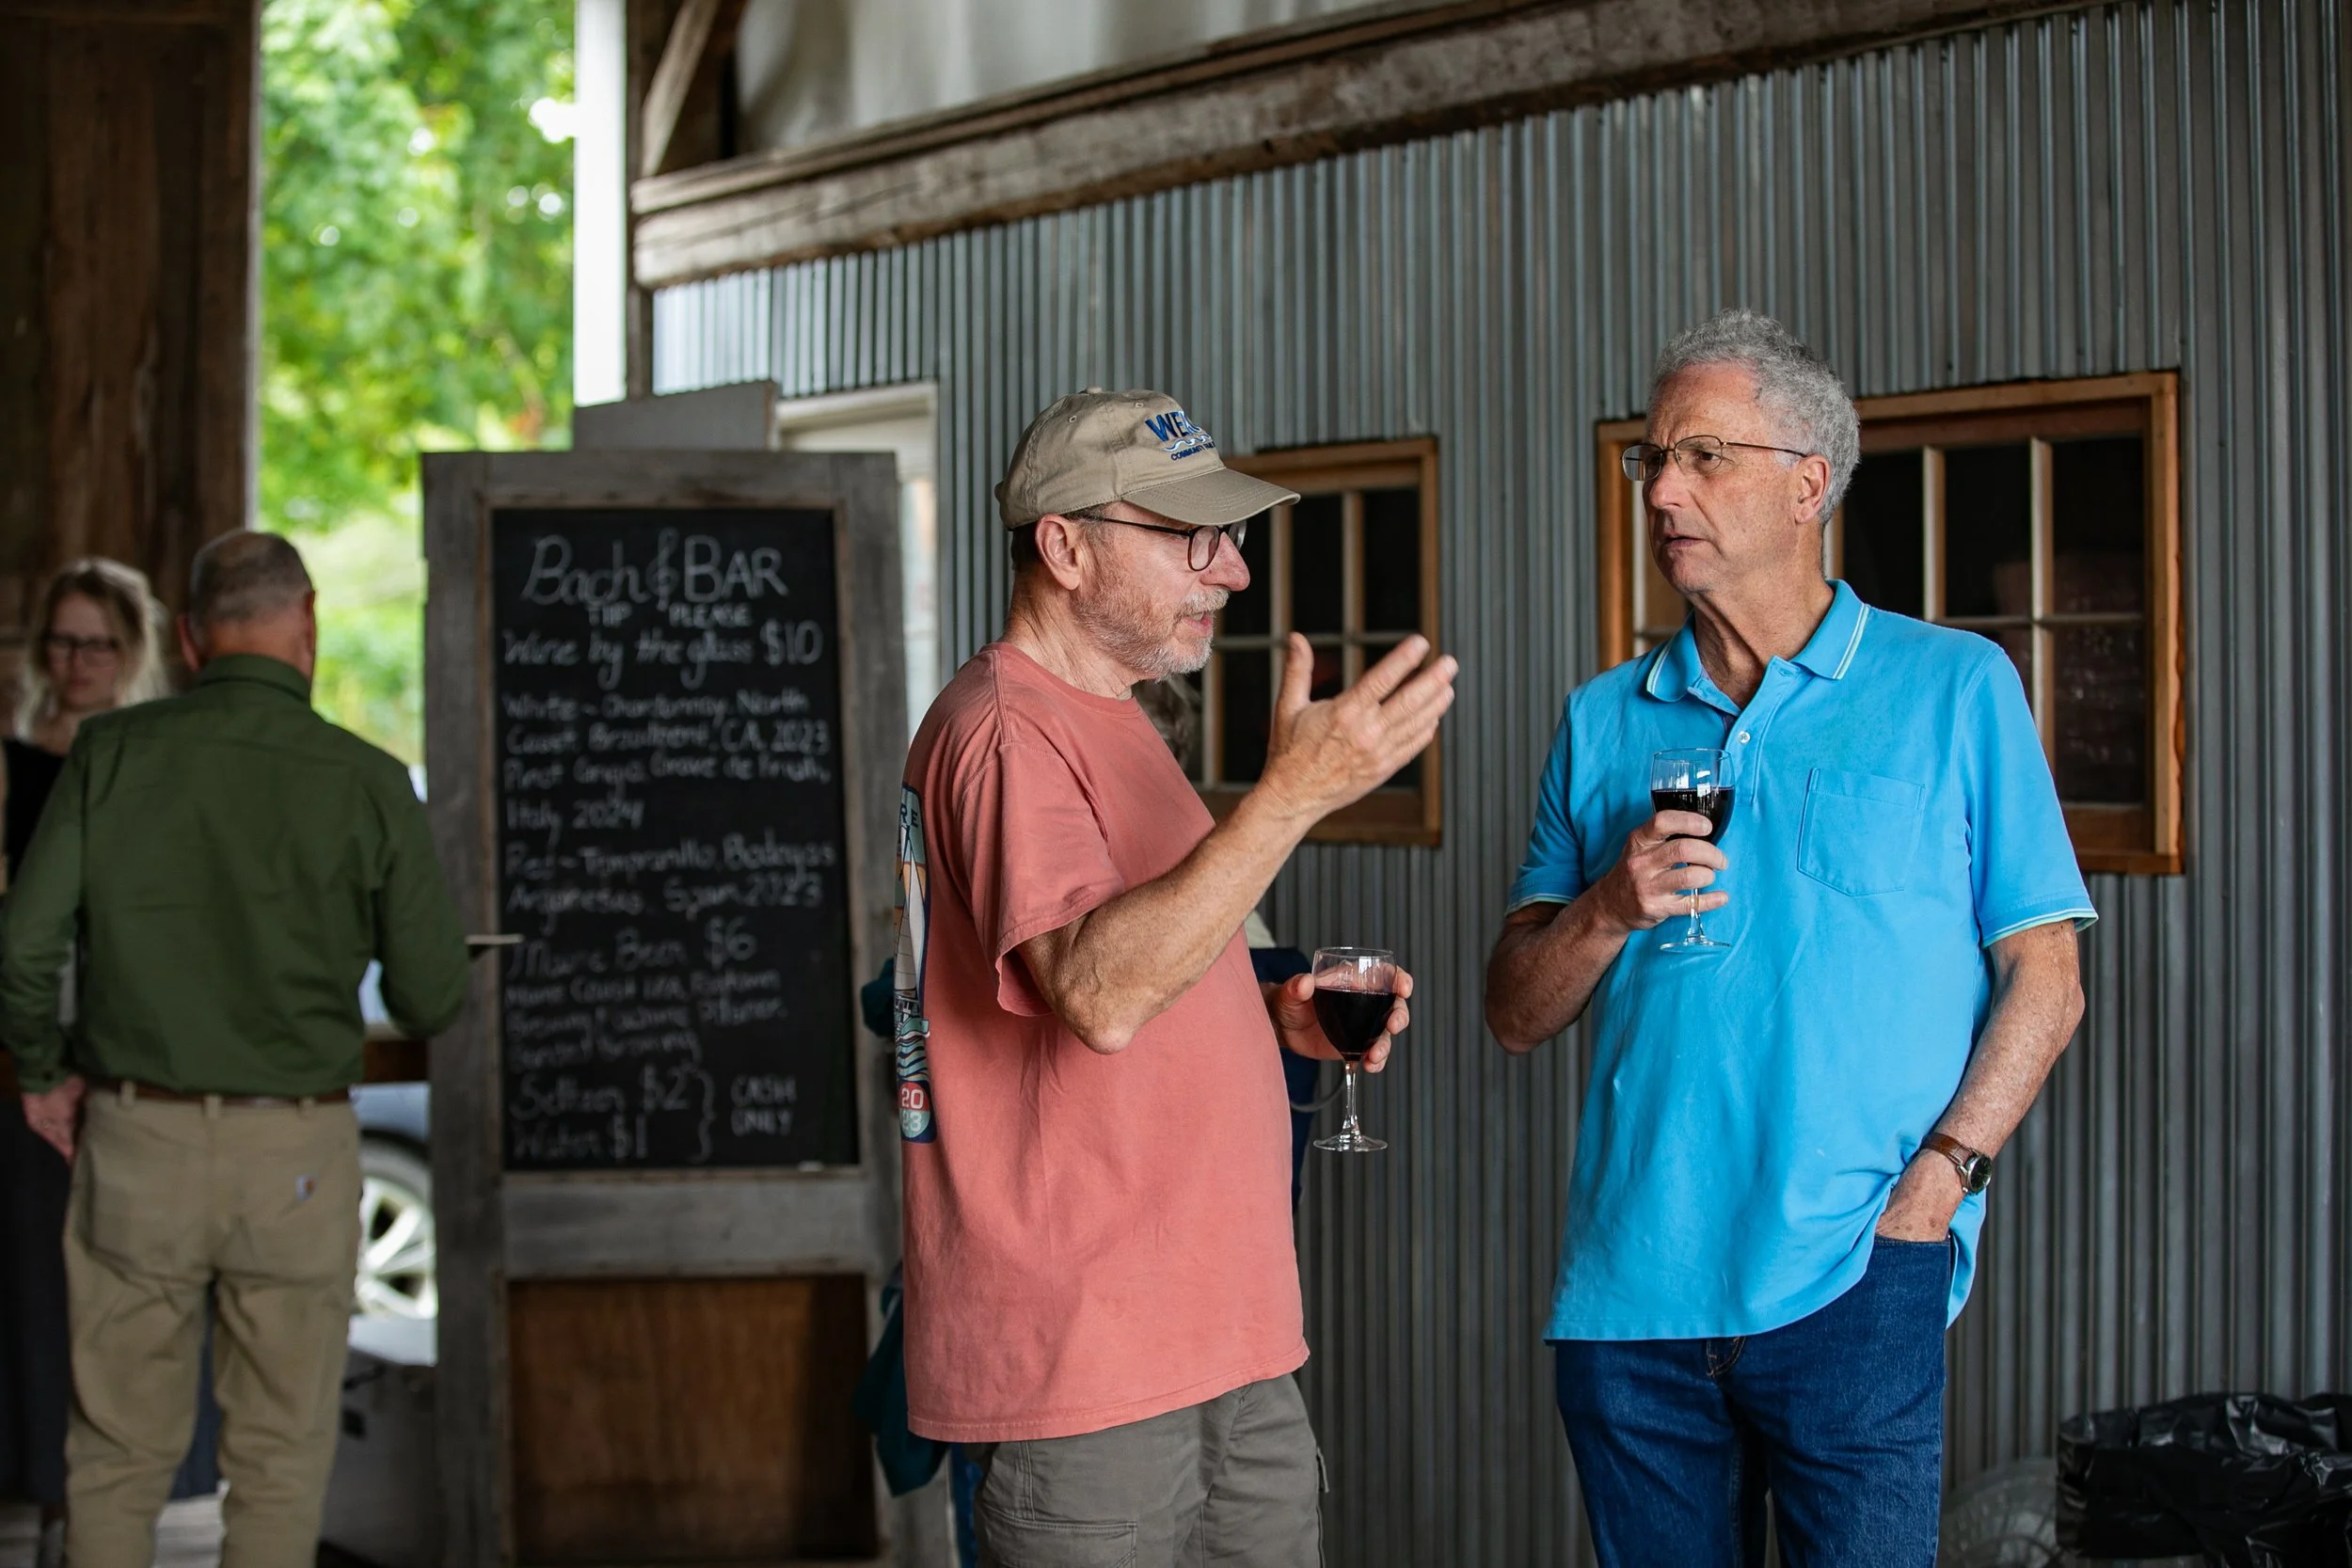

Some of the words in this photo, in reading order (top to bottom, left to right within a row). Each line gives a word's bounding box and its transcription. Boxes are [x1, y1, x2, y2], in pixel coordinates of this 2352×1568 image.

[520, 535, 650, 605] Bach
[684, 535, 788, 602] BAR
[587, 602, 632, 626] TIP
[670, 603, 752, 627] PLEASE
[503, 629, 579, 664] Wine
[589, 630, 623, 689] by
[635, 627, 684, 663] the
[680, 630, 753, 689] glass
[761, 618, 823, 666] $10
[503, 690, 580, 721] White
[738, 686, 810, 715] North
[772, 720, 829, 753] 2023
[503, 758, 564, 792] Pinot
[650, 752, 718, 779] Grave
[723, 756, 754, 780] de
[506, 798, 563, 849] Italy
[572, 800, 644, 829] 2024
[900, 803, 919, 828] RE
[506, 842, 556, 878] Red
[723, 828, 835, 889] Bodegas
[745, 872, 823, 906] 2023
[615, 927, 688, 971] Beer
[705, 916, 756, 969] $6
[640, 1065, 691, 1113] $2
[731, 1075, 797, 1106] CASH
[901, 1087, 924, 1109] 20
[610, 1112, 648, 1163] $1
[731, 1108, 794, 1136] ONLY
